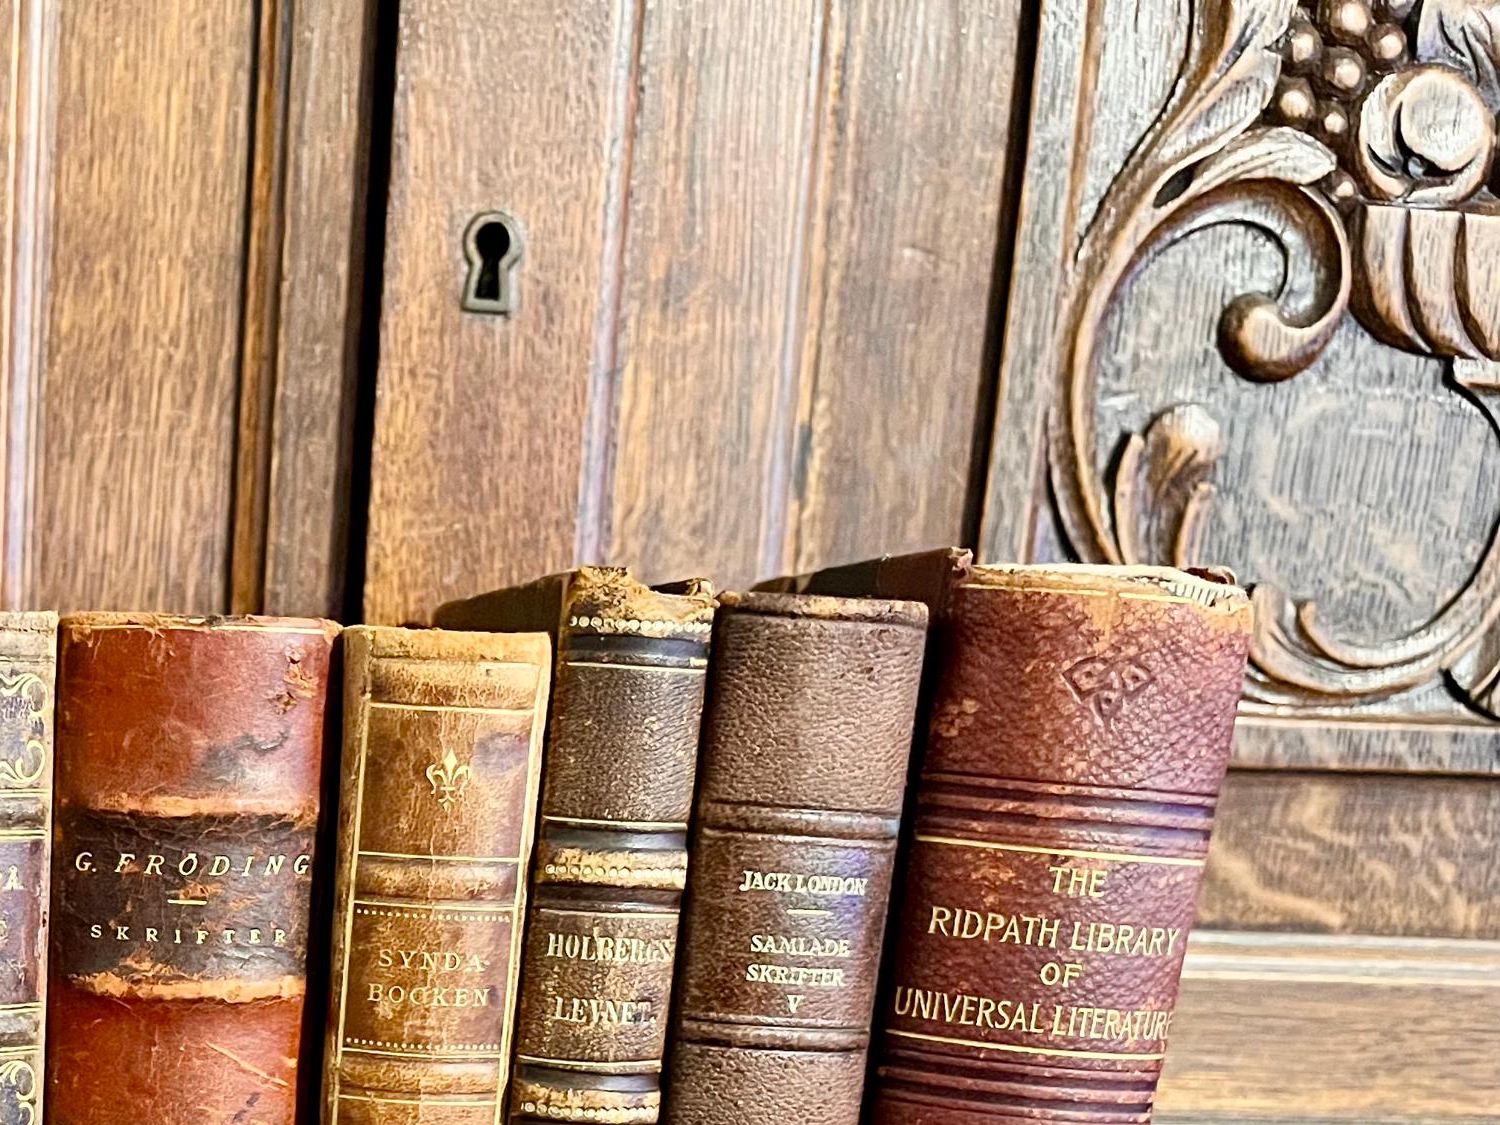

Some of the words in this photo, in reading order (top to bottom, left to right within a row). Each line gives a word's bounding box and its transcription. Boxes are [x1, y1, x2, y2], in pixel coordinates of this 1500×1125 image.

[75, 852, 98, 873] G.
[739, 870, 792, 893] JACK
[794, 874, 869, 896] LONDON
[1049, 866, 1107, 897] THE
[91, 924, 288, 946] SKRIFTER
[927, 905, 1061, 949] RIDPATH
[1069, 920, 1181, 957] LIBRARY
[547, 933, 675, 963] HOLBERGS
[750, 935, 851, 958] SAMLADE
[746, 964, 846, 987] SKRIFTER
[1039, 962, 1083, 988] OF
[367, 983, 491, 1008] BOCKEN
[787, 994, 804, 1013] V
[894, 985, 1045, 1035] UNIVERSAL
